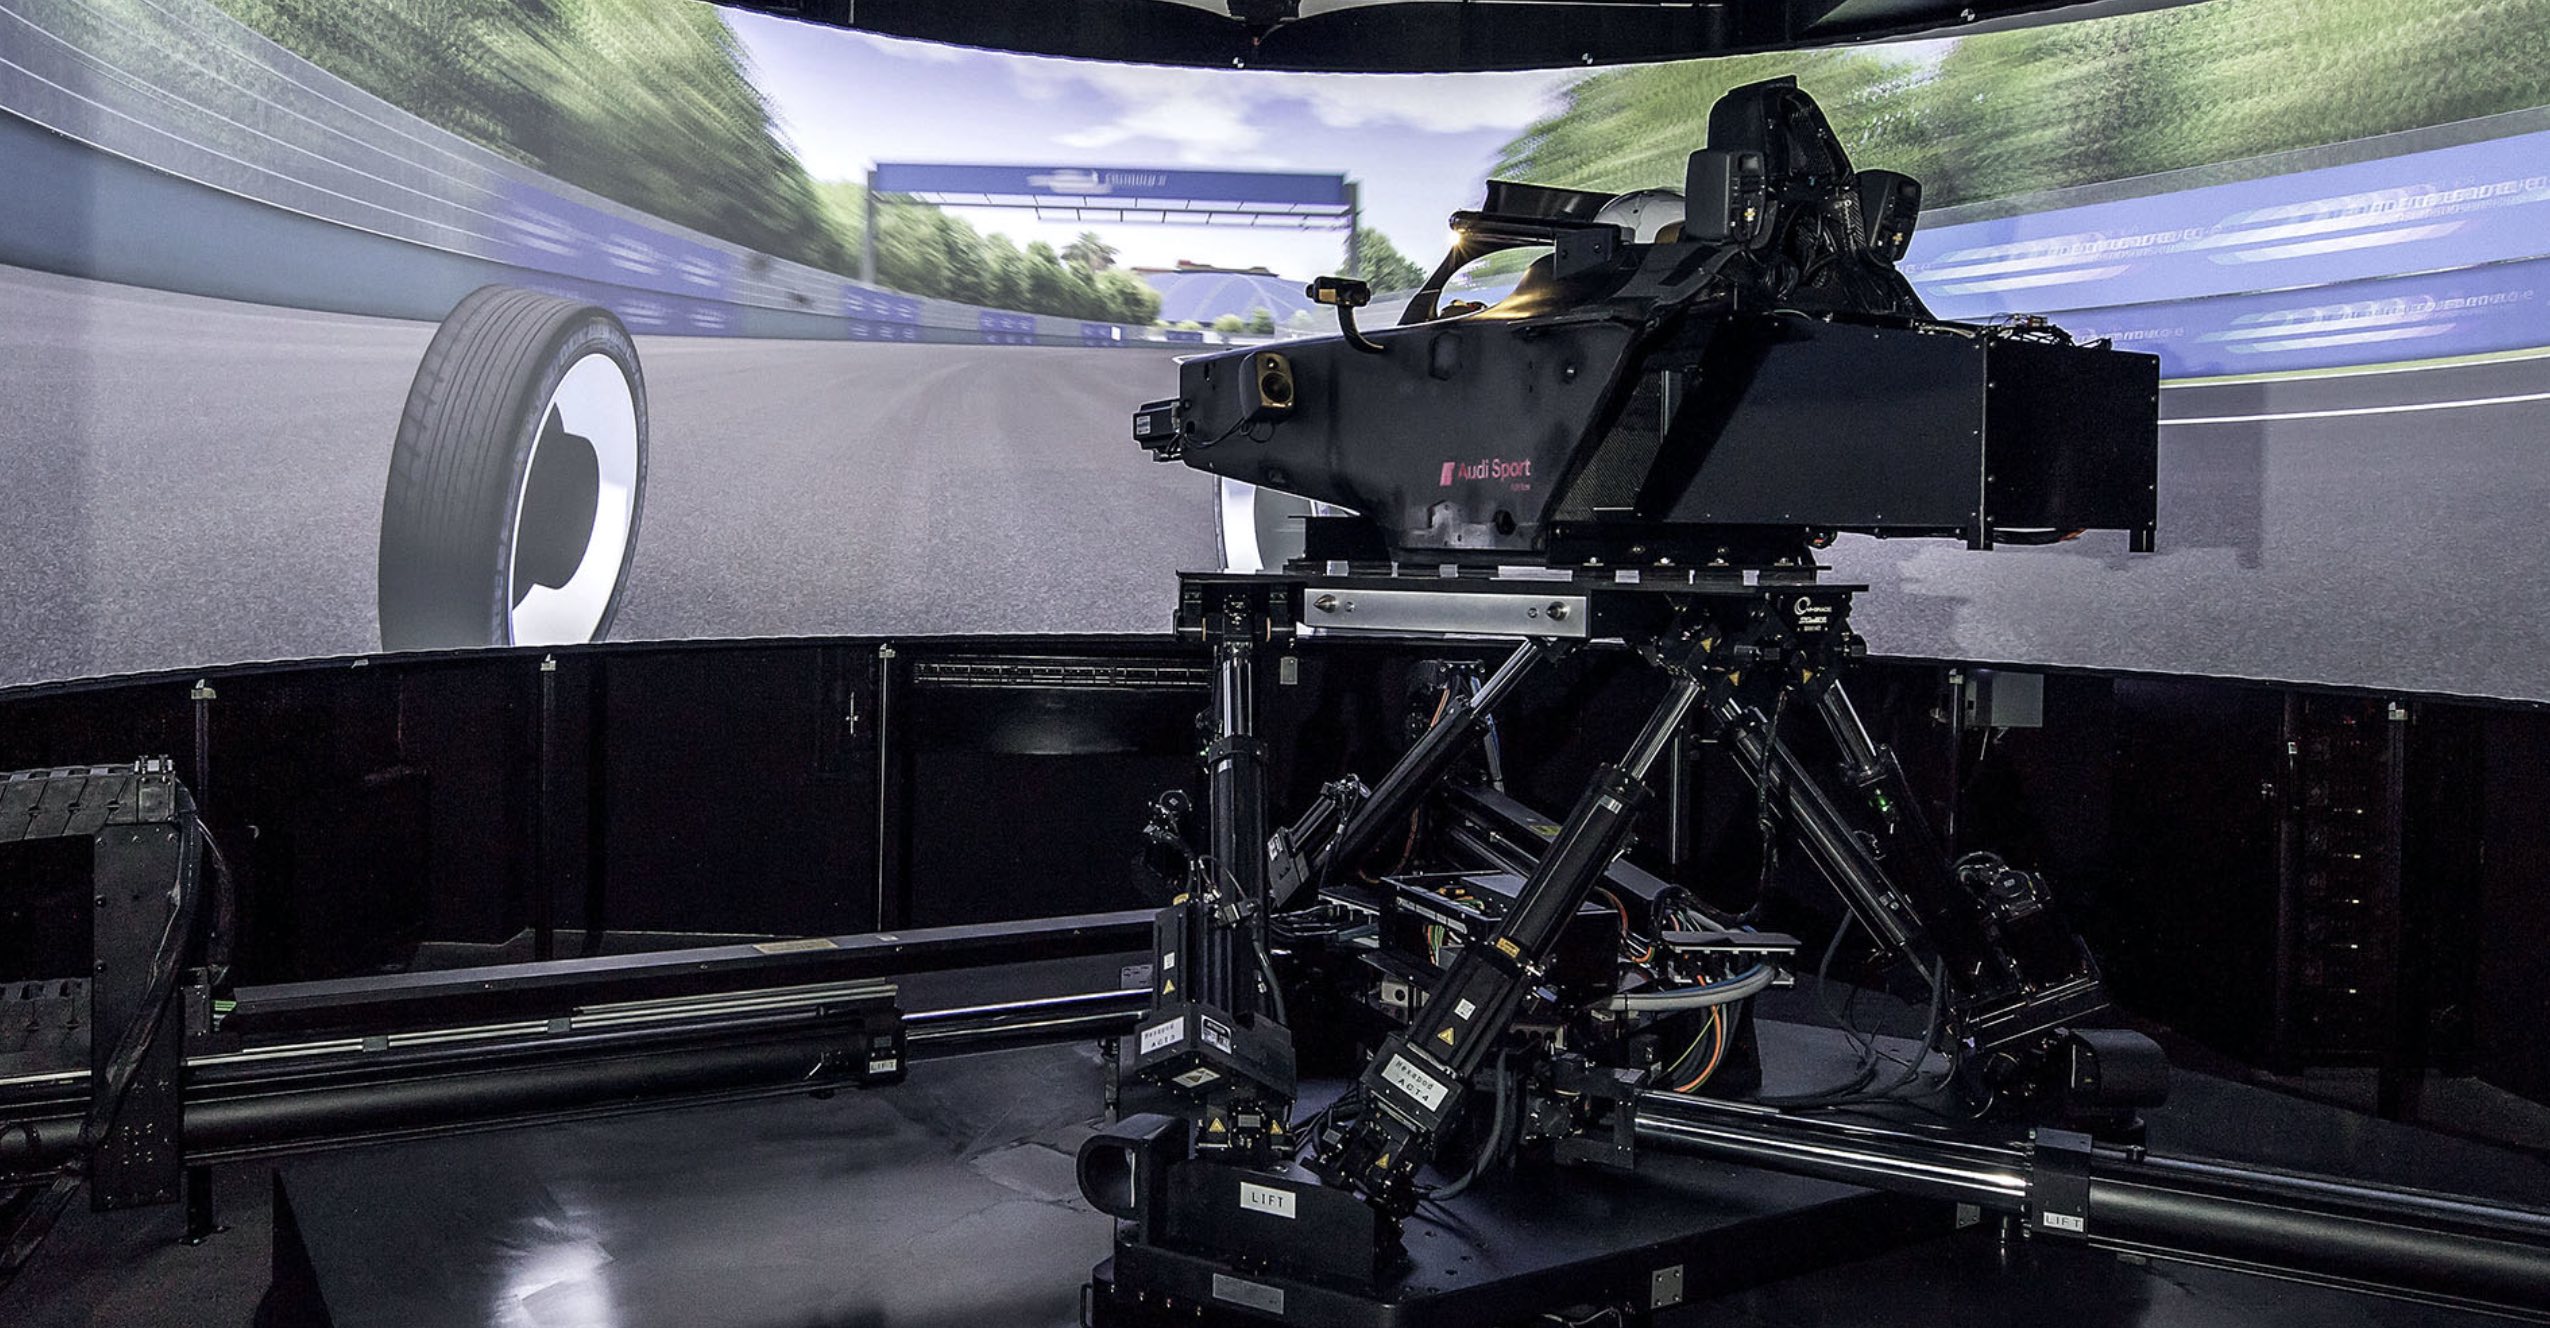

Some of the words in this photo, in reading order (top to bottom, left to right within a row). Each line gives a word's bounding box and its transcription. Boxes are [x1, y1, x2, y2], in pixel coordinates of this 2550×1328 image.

[1458, 459, 1489, 480] Audi
[1491, 458, 1531, 482] Sport
[1252, 1192, 1283, 1208] LIFT
[2045, 1214, 2081, 1229] LIFT
